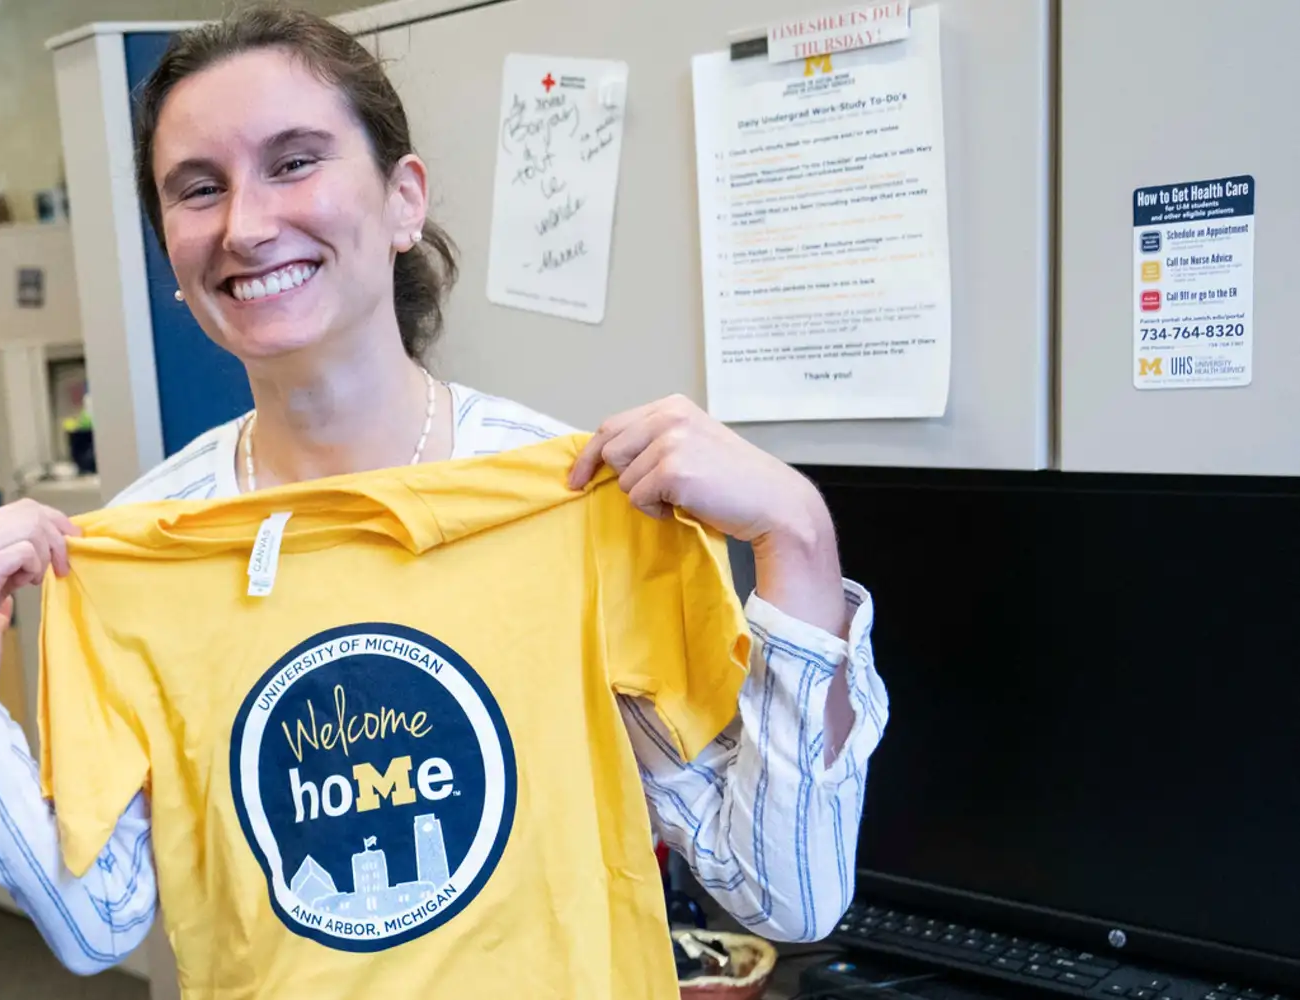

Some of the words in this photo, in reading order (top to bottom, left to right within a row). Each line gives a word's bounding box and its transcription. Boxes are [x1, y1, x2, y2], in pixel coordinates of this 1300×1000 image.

[771, 11, 868, 42] TIMESHEETS
[872, 2, 903, 22] DUE
[792, 27, 882, 58] THURSDAY!
[737, 119, 759, 130] Daily
[761, 107, 810, 125] Undergrad
[1137, 191, 1158, 207] How
[1159, 189, 1170, 205] to
[1172, 187, 1189, 203] Get
[1191, 182, 1223, 201] Health
[1225, 180, 1249, 197] Care
[1150, 213, 1163, 222] and
[1163, 211, 1182, 221] other
[1183, 208, 1206, 219] eligible
[1207, 206, 1234, 218] patients
[1164, 204, 1175, 212] for
[1176, 202, 1190, 211] U-M
[1191, 199, 1220, 209] students
[1166, 227, 1196, 241] Schedule
[1196, 228, 1205, 238] an
[1205, 223, 1249, 239] Appointment
[1166, 257, 1179, 267] Call
[1180, 256, 1189, 266] for
[1190, 254, 1210, 266] Nurse
[1211, 252, 1233, 263] Advice
[1166, 292, 1179, 302] Call
[1180, 290, 1190, 301] 911
[1190, 291, 1198, 301] or
[1199, 290, 1208, 303] go
[1208, 288, 1216, 300] to
[1217, 288, 1228, 299] the
[1228, 286, 1238, 298] ER
[1139, 322, 1245, 342] 734-764-8320
[1138, 357, 1163, 376] M
[1170, 355, 1194, 376] UHS
[1194, 359, 1233, 368] UNIVERSITY
[1194, 366, 1219, 375] HEALTH
[1220, 365, 1246, 375] SERVICE
[804, 370, 830, 381] Thank
[832, 368, 853, 381] you!
[252, 529, 272, 573] CANVAS
[257, 645, 335, 712] UNIVERSITY
[338, 638, 361, 653] OF
[364, 637, 444, 675] MICHIGAN
[281, 683, 433, 764] Welcome
[288, 755, 454, 824] hoMe
[291, 904, 323, 928] ANN
[324, 918, 381, 938] ARBOR,
[384, 883, 458, 933] MICHIGAN
